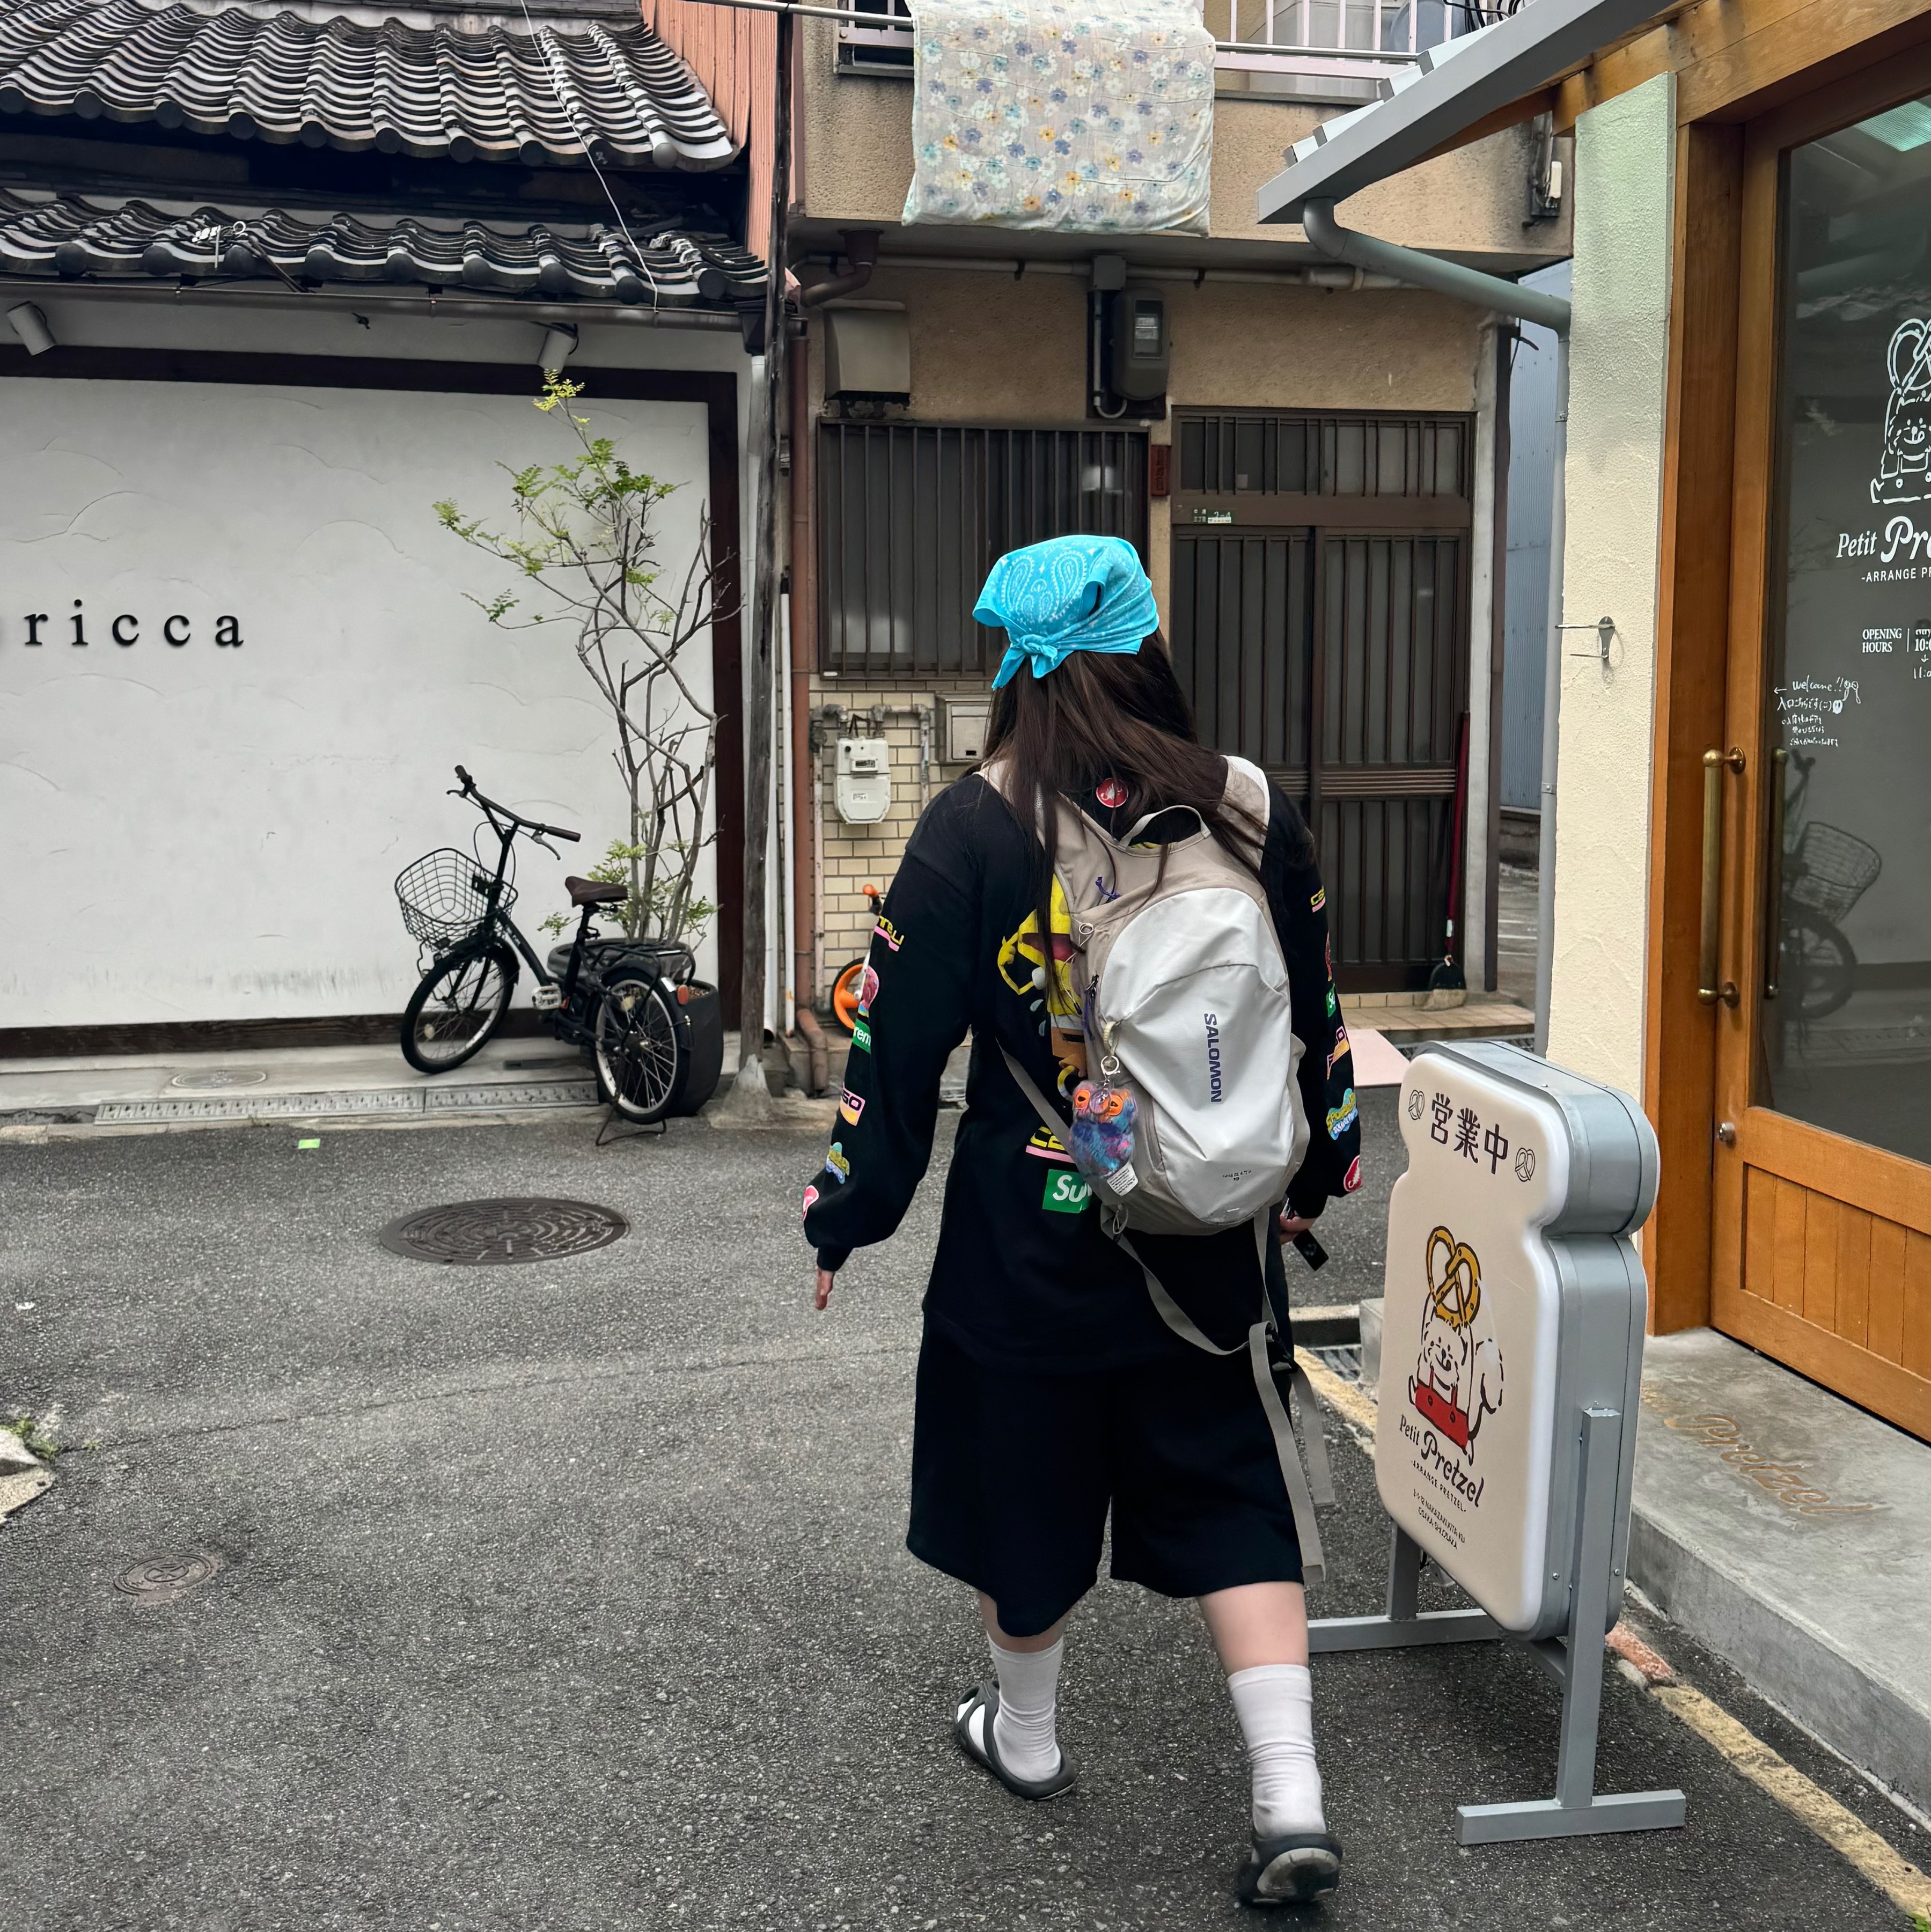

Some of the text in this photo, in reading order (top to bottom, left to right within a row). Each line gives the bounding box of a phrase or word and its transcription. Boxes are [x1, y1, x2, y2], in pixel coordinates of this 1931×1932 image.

[1835, 530, 1877, 559] Petit
[1862, 628, 1902, 640] OPENING
[1862, 642, 1892, 653] HOURS
[1204, 1013, 1222, 1103] SALOMON
[1431, 1092, 1509, 1175] 営業中
[1399, 1414, 1485, 1508] Petit Pretzel
